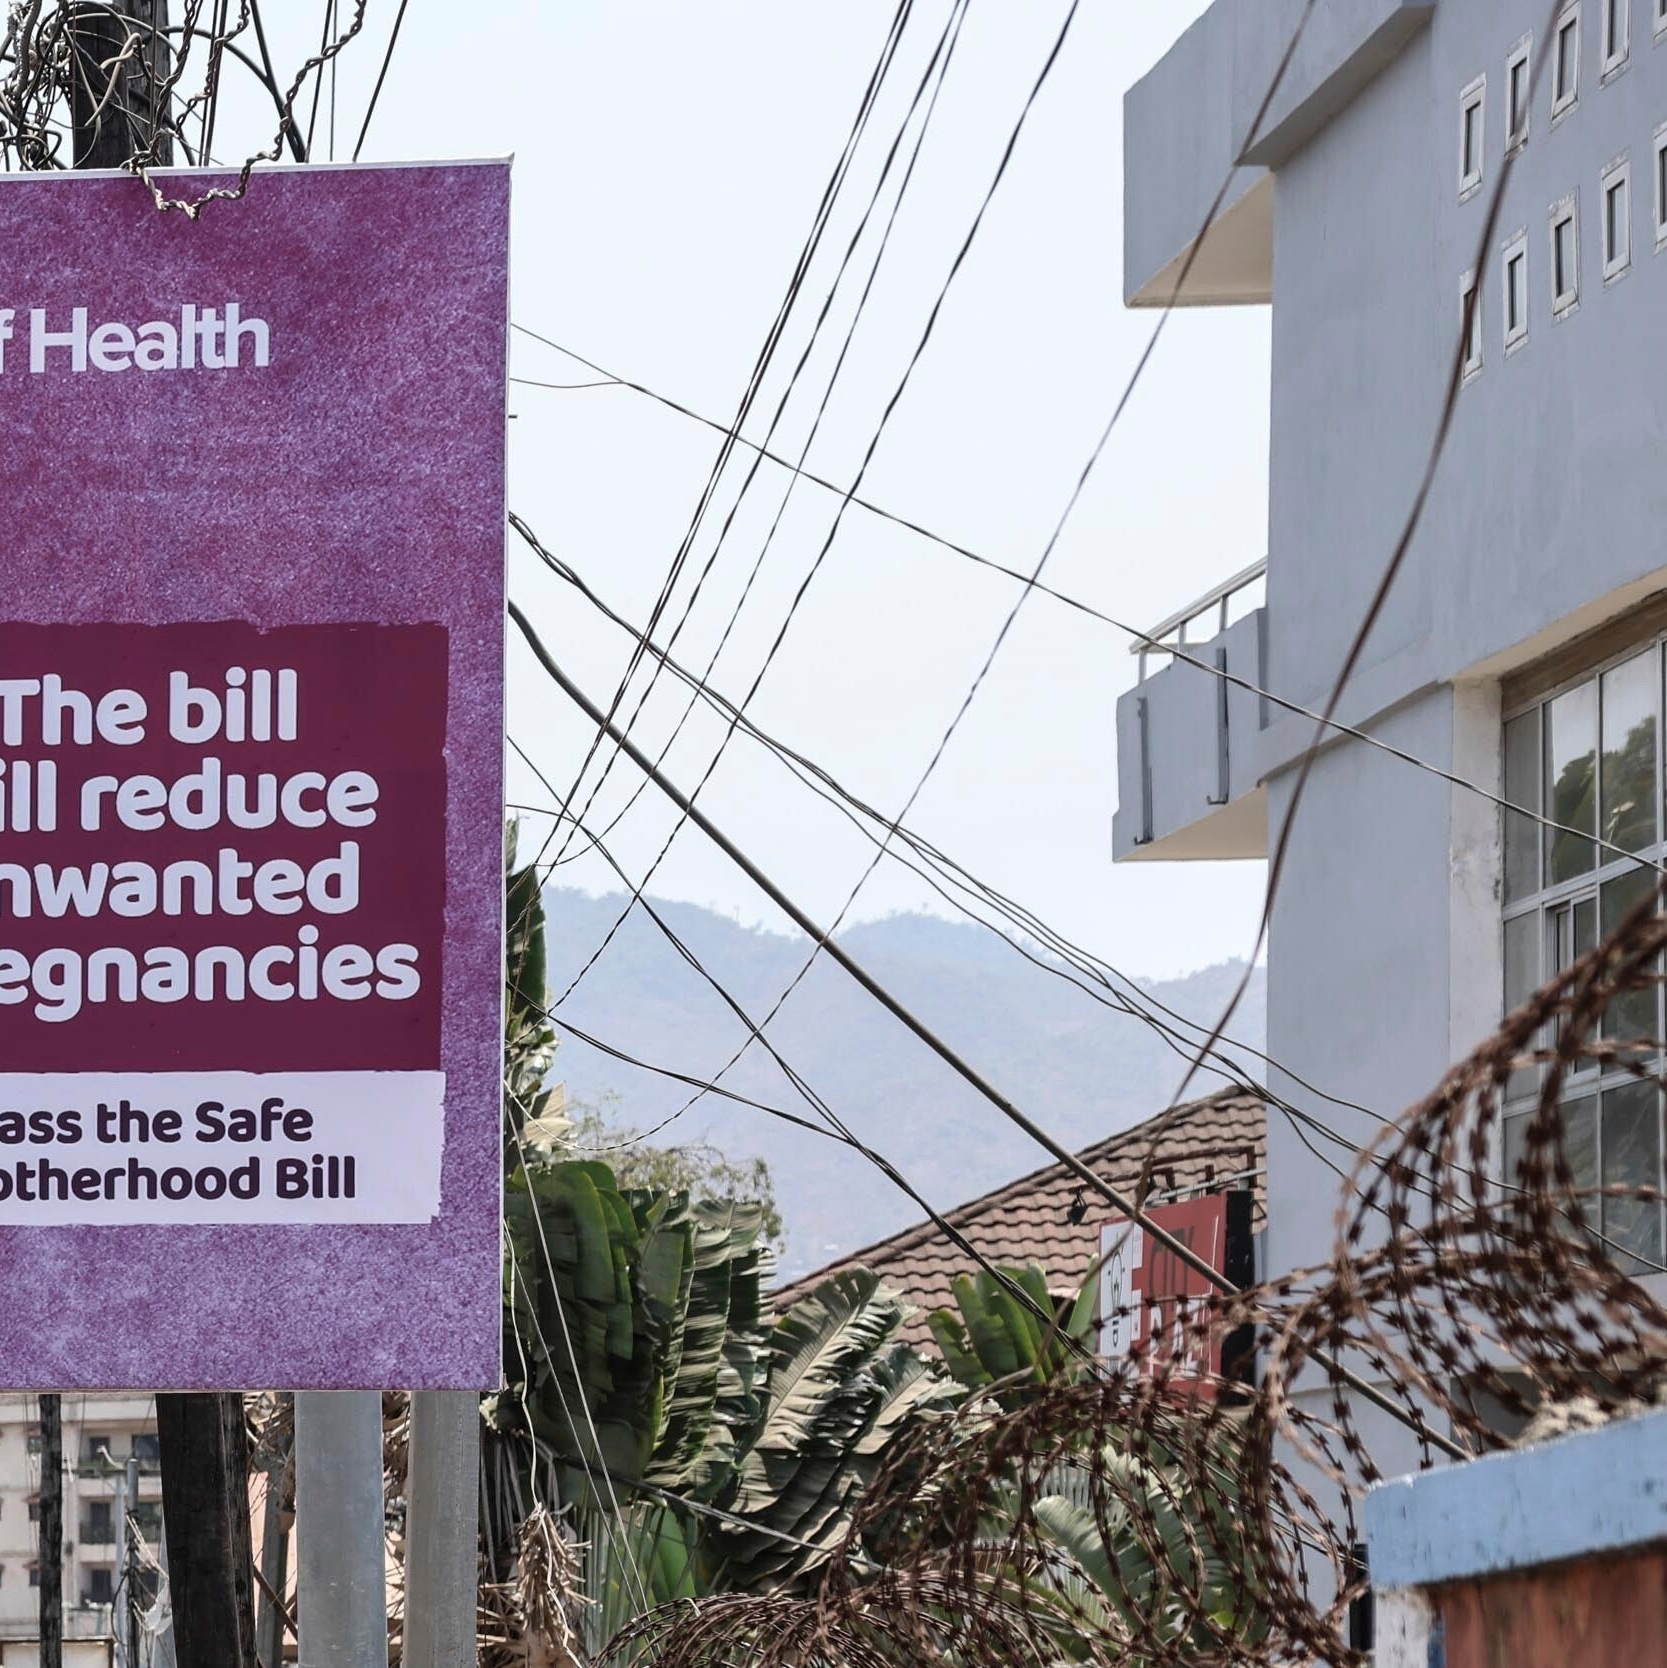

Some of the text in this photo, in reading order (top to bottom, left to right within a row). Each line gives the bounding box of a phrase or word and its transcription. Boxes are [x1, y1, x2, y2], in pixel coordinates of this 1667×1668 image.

[30, 303, 270, 374] Health
[170, 666, 297, 744] bill
[80, 757, 379, 831] reduce
[97, 1100, 182, 1143] the
[195, 1097, 313, 1142] Safe
[276, 1154, 356, 1198] Bill
